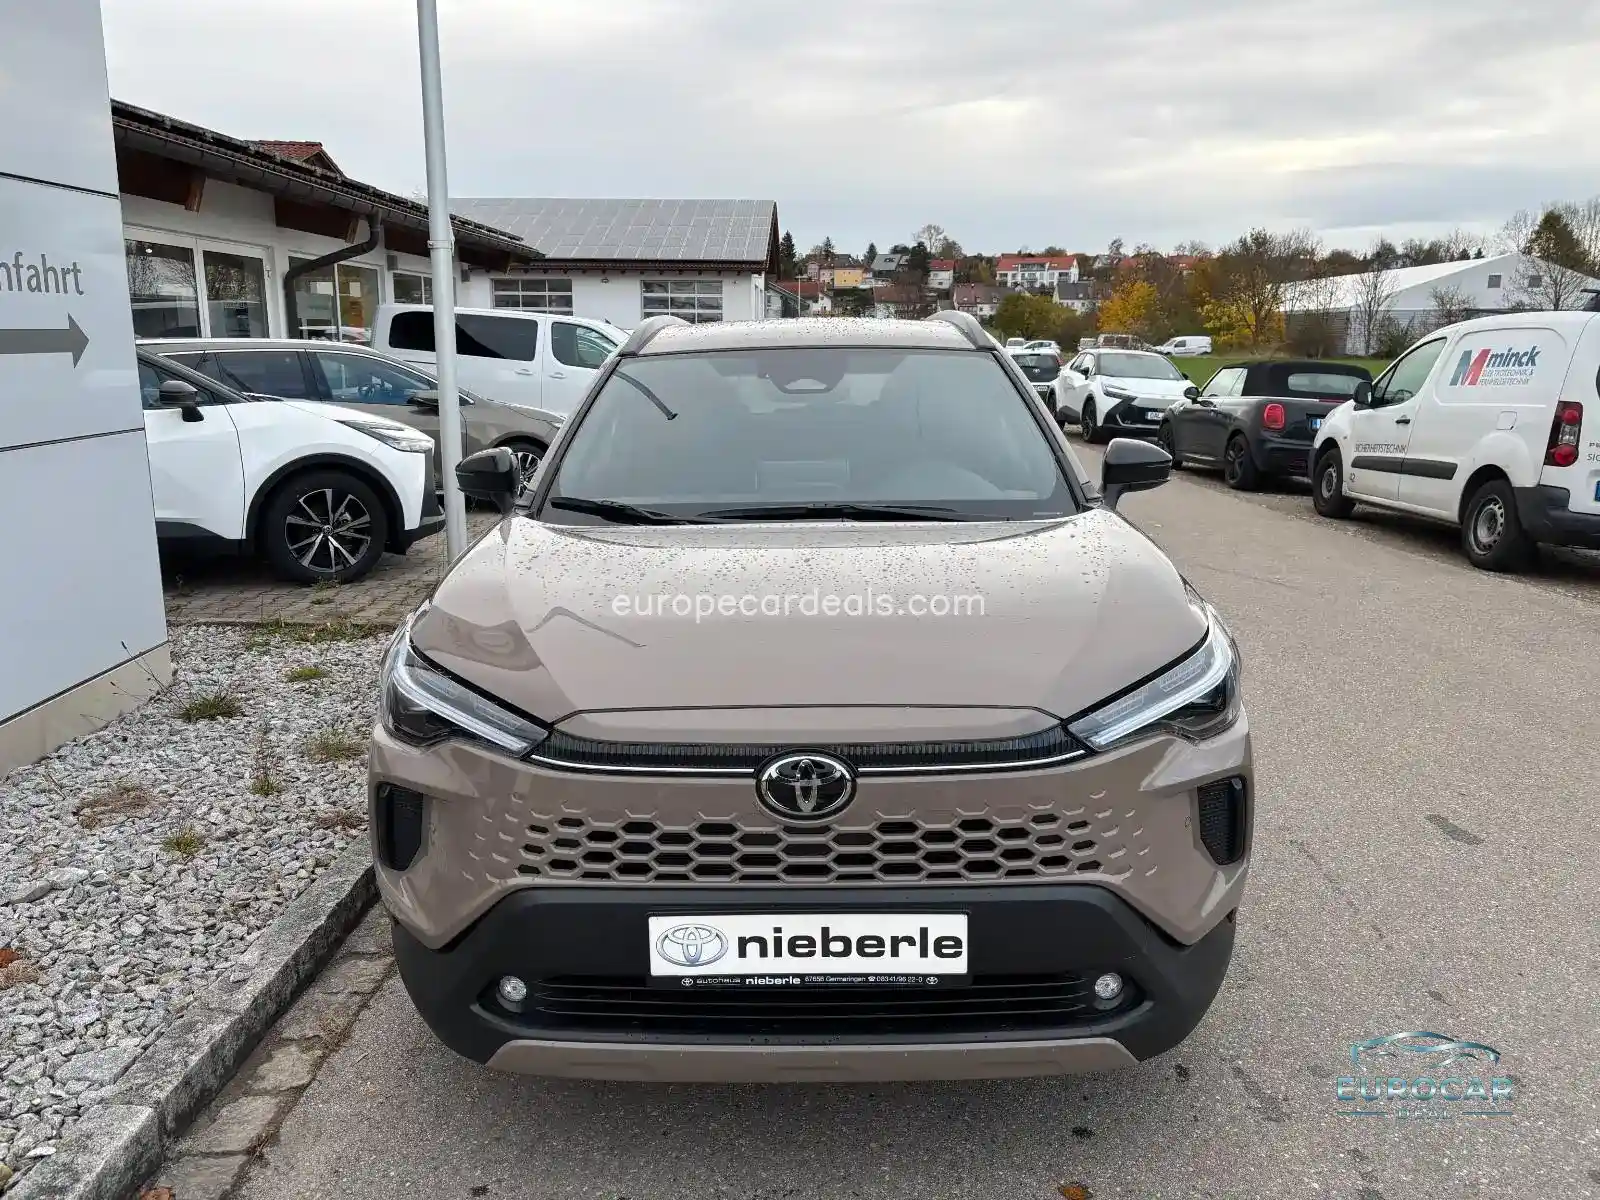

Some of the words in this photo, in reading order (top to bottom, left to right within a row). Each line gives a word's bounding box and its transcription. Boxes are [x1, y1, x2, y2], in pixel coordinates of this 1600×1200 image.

[1486, 345, 1541, 368] minck
[737, 926, 963, 959] nieberle
[696, 977, 741, 985] autohaus
[745, 975, 802, 985] nieberle
